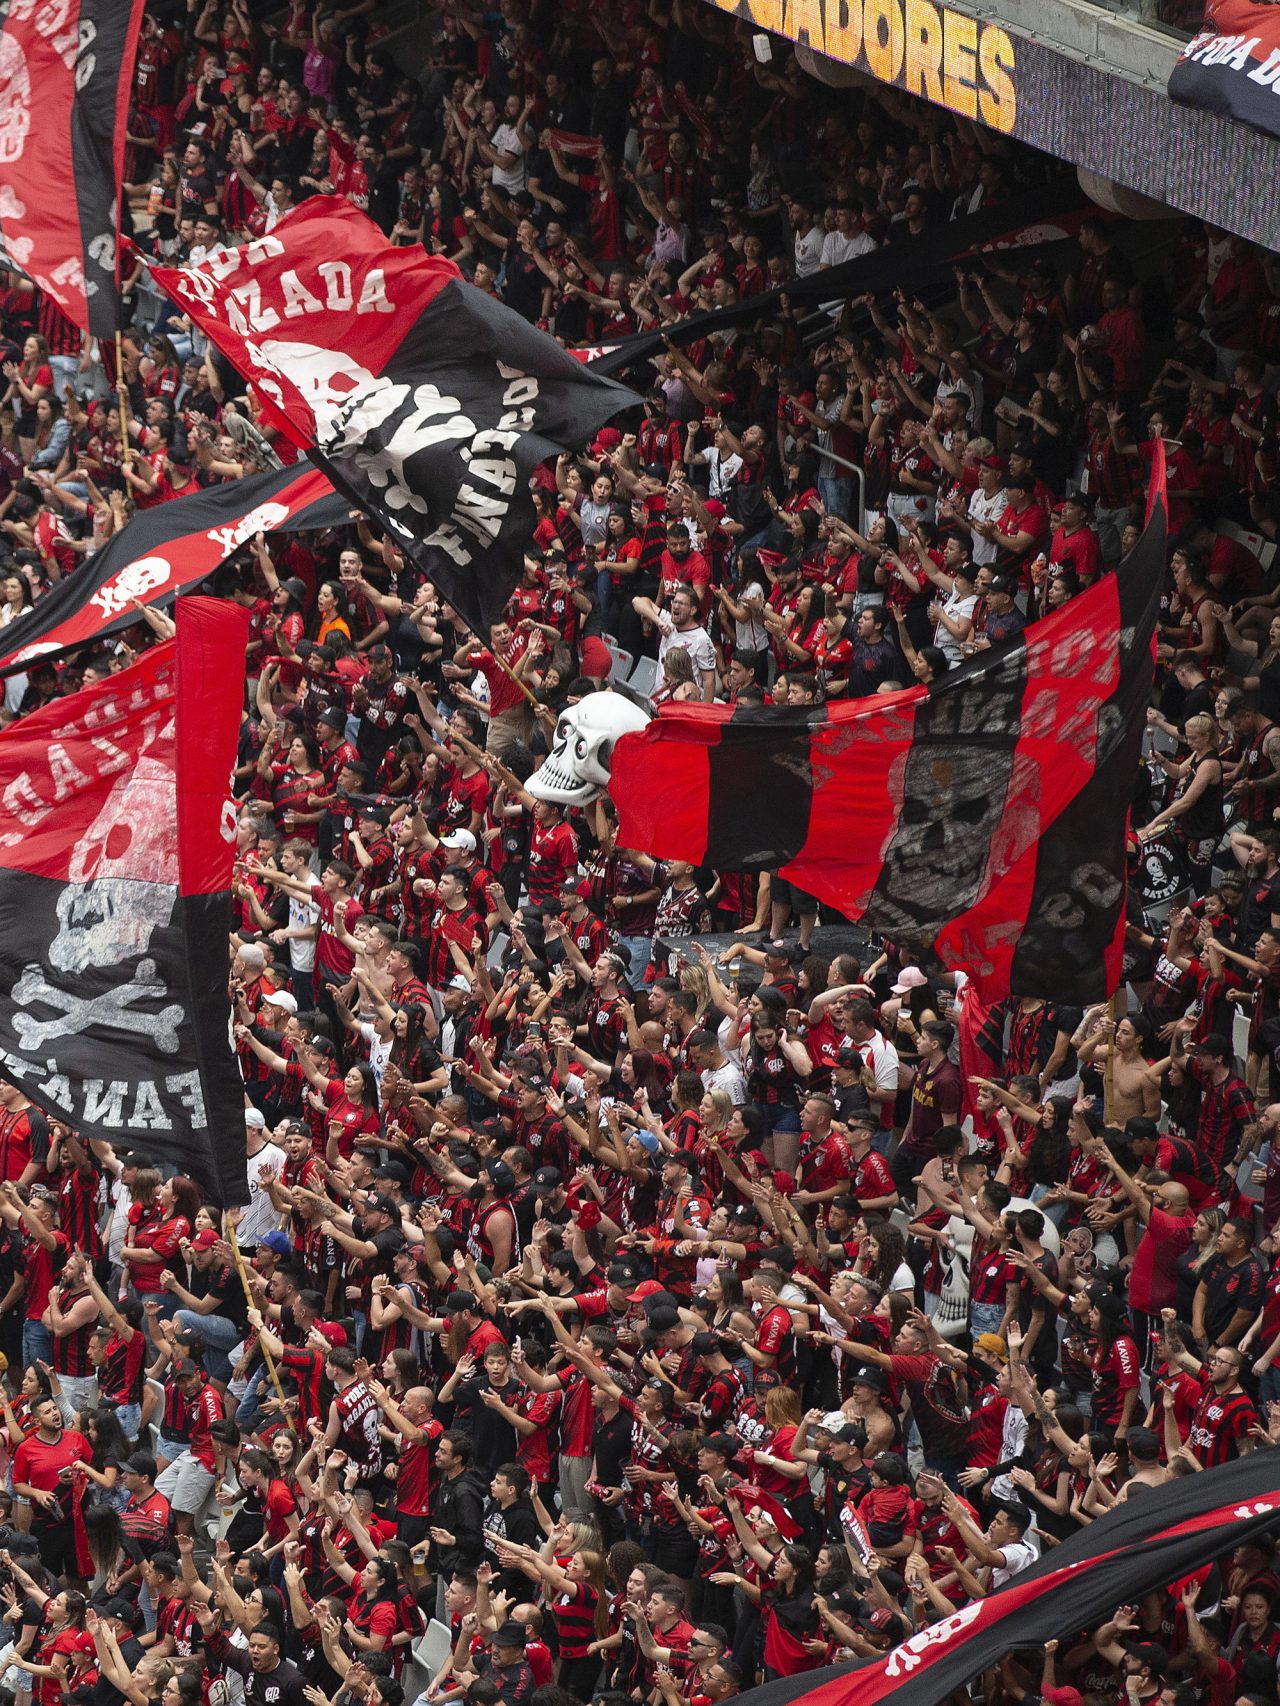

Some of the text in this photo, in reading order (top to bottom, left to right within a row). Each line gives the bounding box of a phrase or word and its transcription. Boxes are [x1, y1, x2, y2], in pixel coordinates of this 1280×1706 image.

[718, 0, 1017, 134] ADORES
[870, 1153, 889, 1185] HAVAN
[766, 1314, 782, 1348] HAVAN
[1115, 1338, 1133, 1375] HAVAN
[204, 1389, 218, 1424] HAVAN
